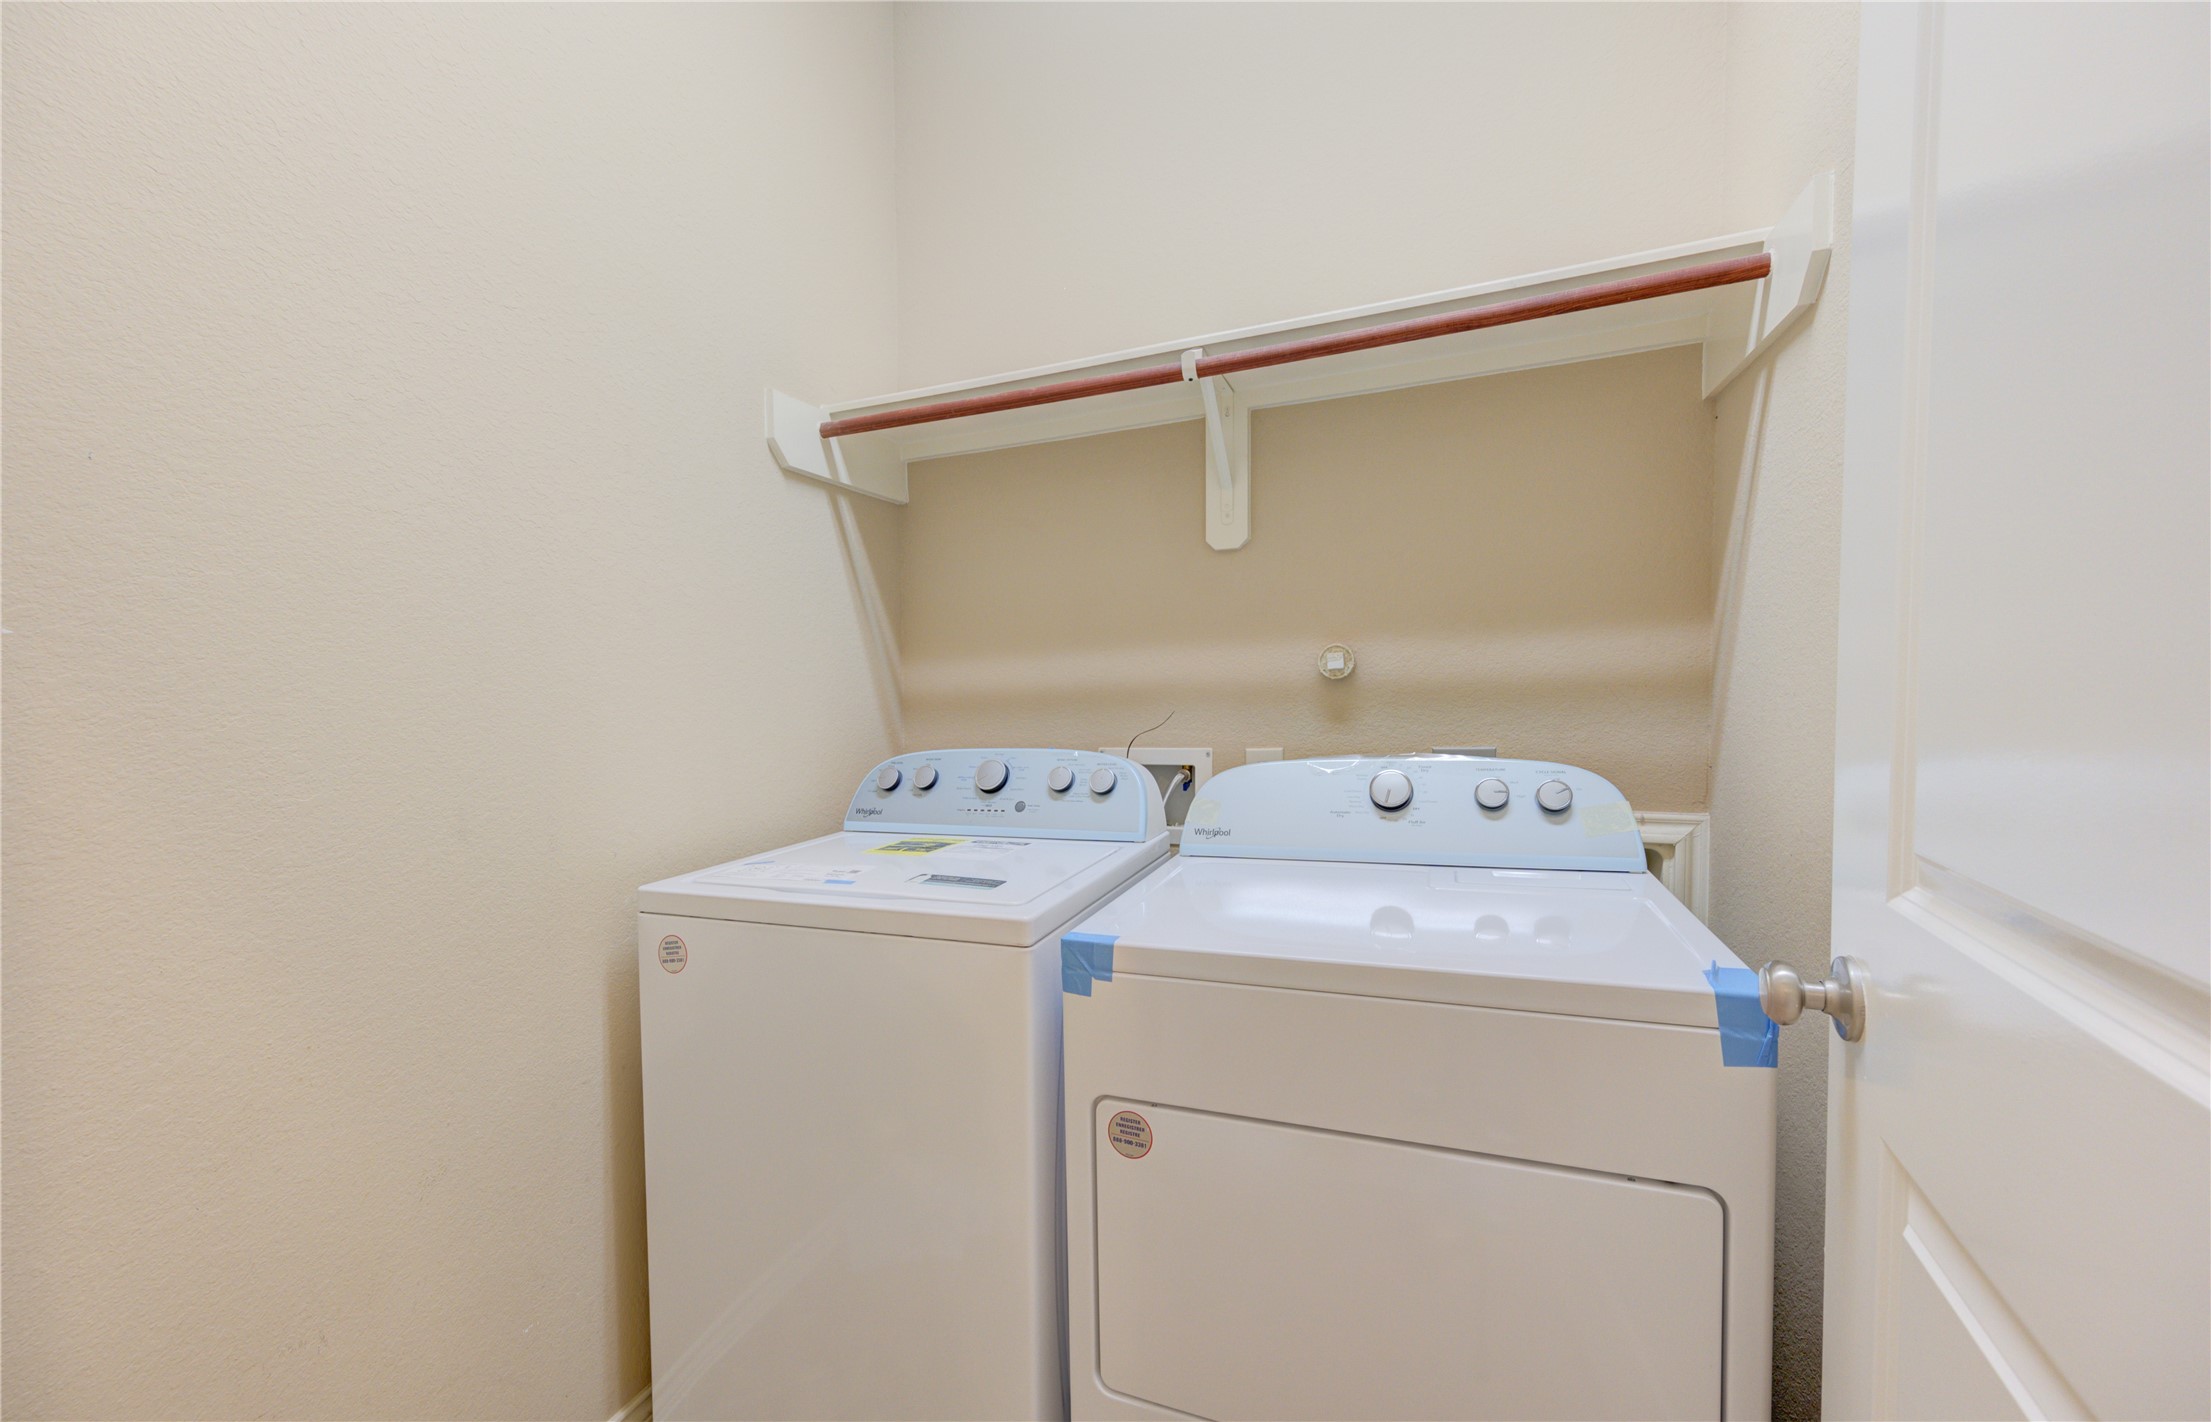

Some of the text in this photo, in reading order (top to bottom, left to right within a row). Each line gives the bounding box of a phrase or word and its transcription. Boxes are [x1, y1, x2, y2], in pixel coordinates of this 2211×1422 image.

[855, 807, 883, 818] Whirlpool
[1193, 827, 1232, 840] Whirlpool
[1120, 1117, 1141, 1125] REGISTER
